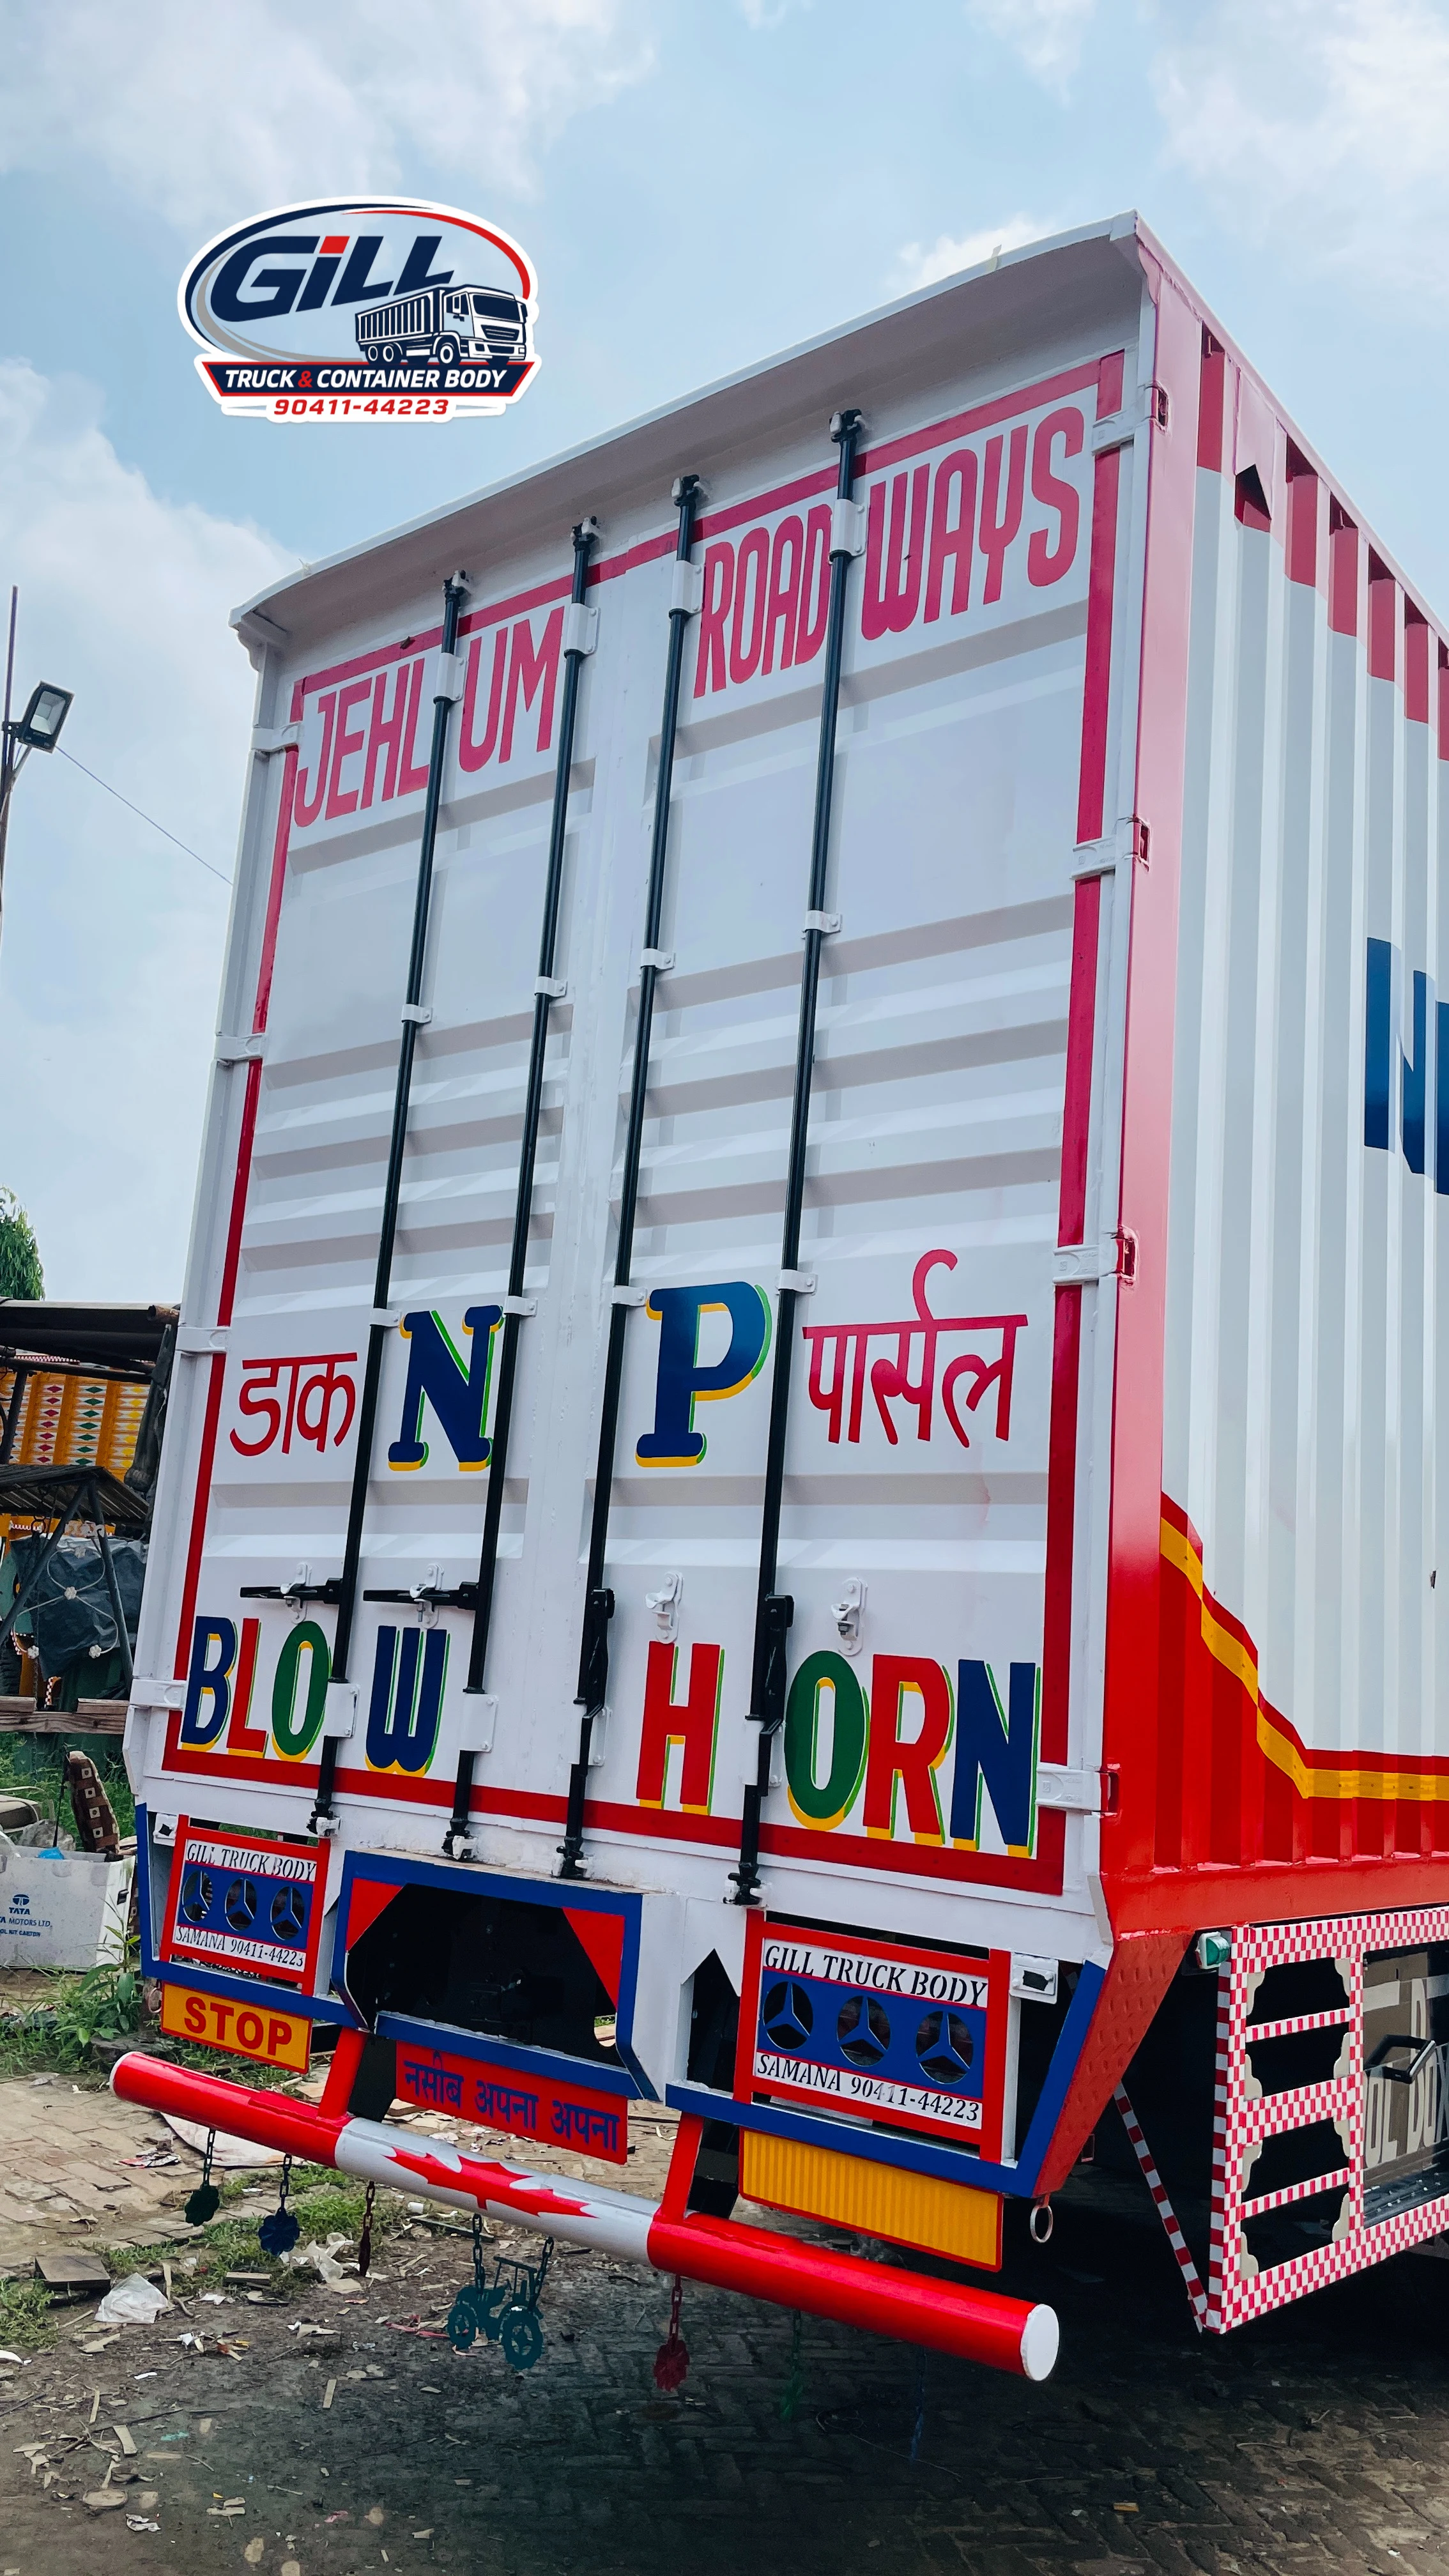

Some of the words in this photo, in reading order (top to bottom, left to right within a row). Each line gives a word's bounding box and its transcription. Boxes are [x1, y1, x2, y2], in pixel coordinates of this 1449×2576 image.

[388, 1305, 503, 1471] N
[635, 1281, 772, 1467] P
[802, 1249, 1029, 1448] पार्सल
[229, 1352, 358, 1456] डाक
[187, 1843, 216, 1866] GILL
[221, 1848, 272, 1876] TRUCK
[271, 1856, 317, 1882] BODY
[8, 1917, 37, 1926] MOTORS
[176, 1926, 225, 1951] SAMANA
[231, 1938, 304, 1968] 90411-44223
[765, 1945, 815, 1976] GILL
[822, 1954, 906, 1993] TRUCK
[909, 1970, 988, 2007] BODY
[184, 1996, 293, 2056] STOP
[475, 2080, 539, 2130] अपना
[551, 2099, 621, 2150] अपना
[757, 2053, 841, 2092] SAMANA
[851, 2076, 979, 2121] 90411-44223
